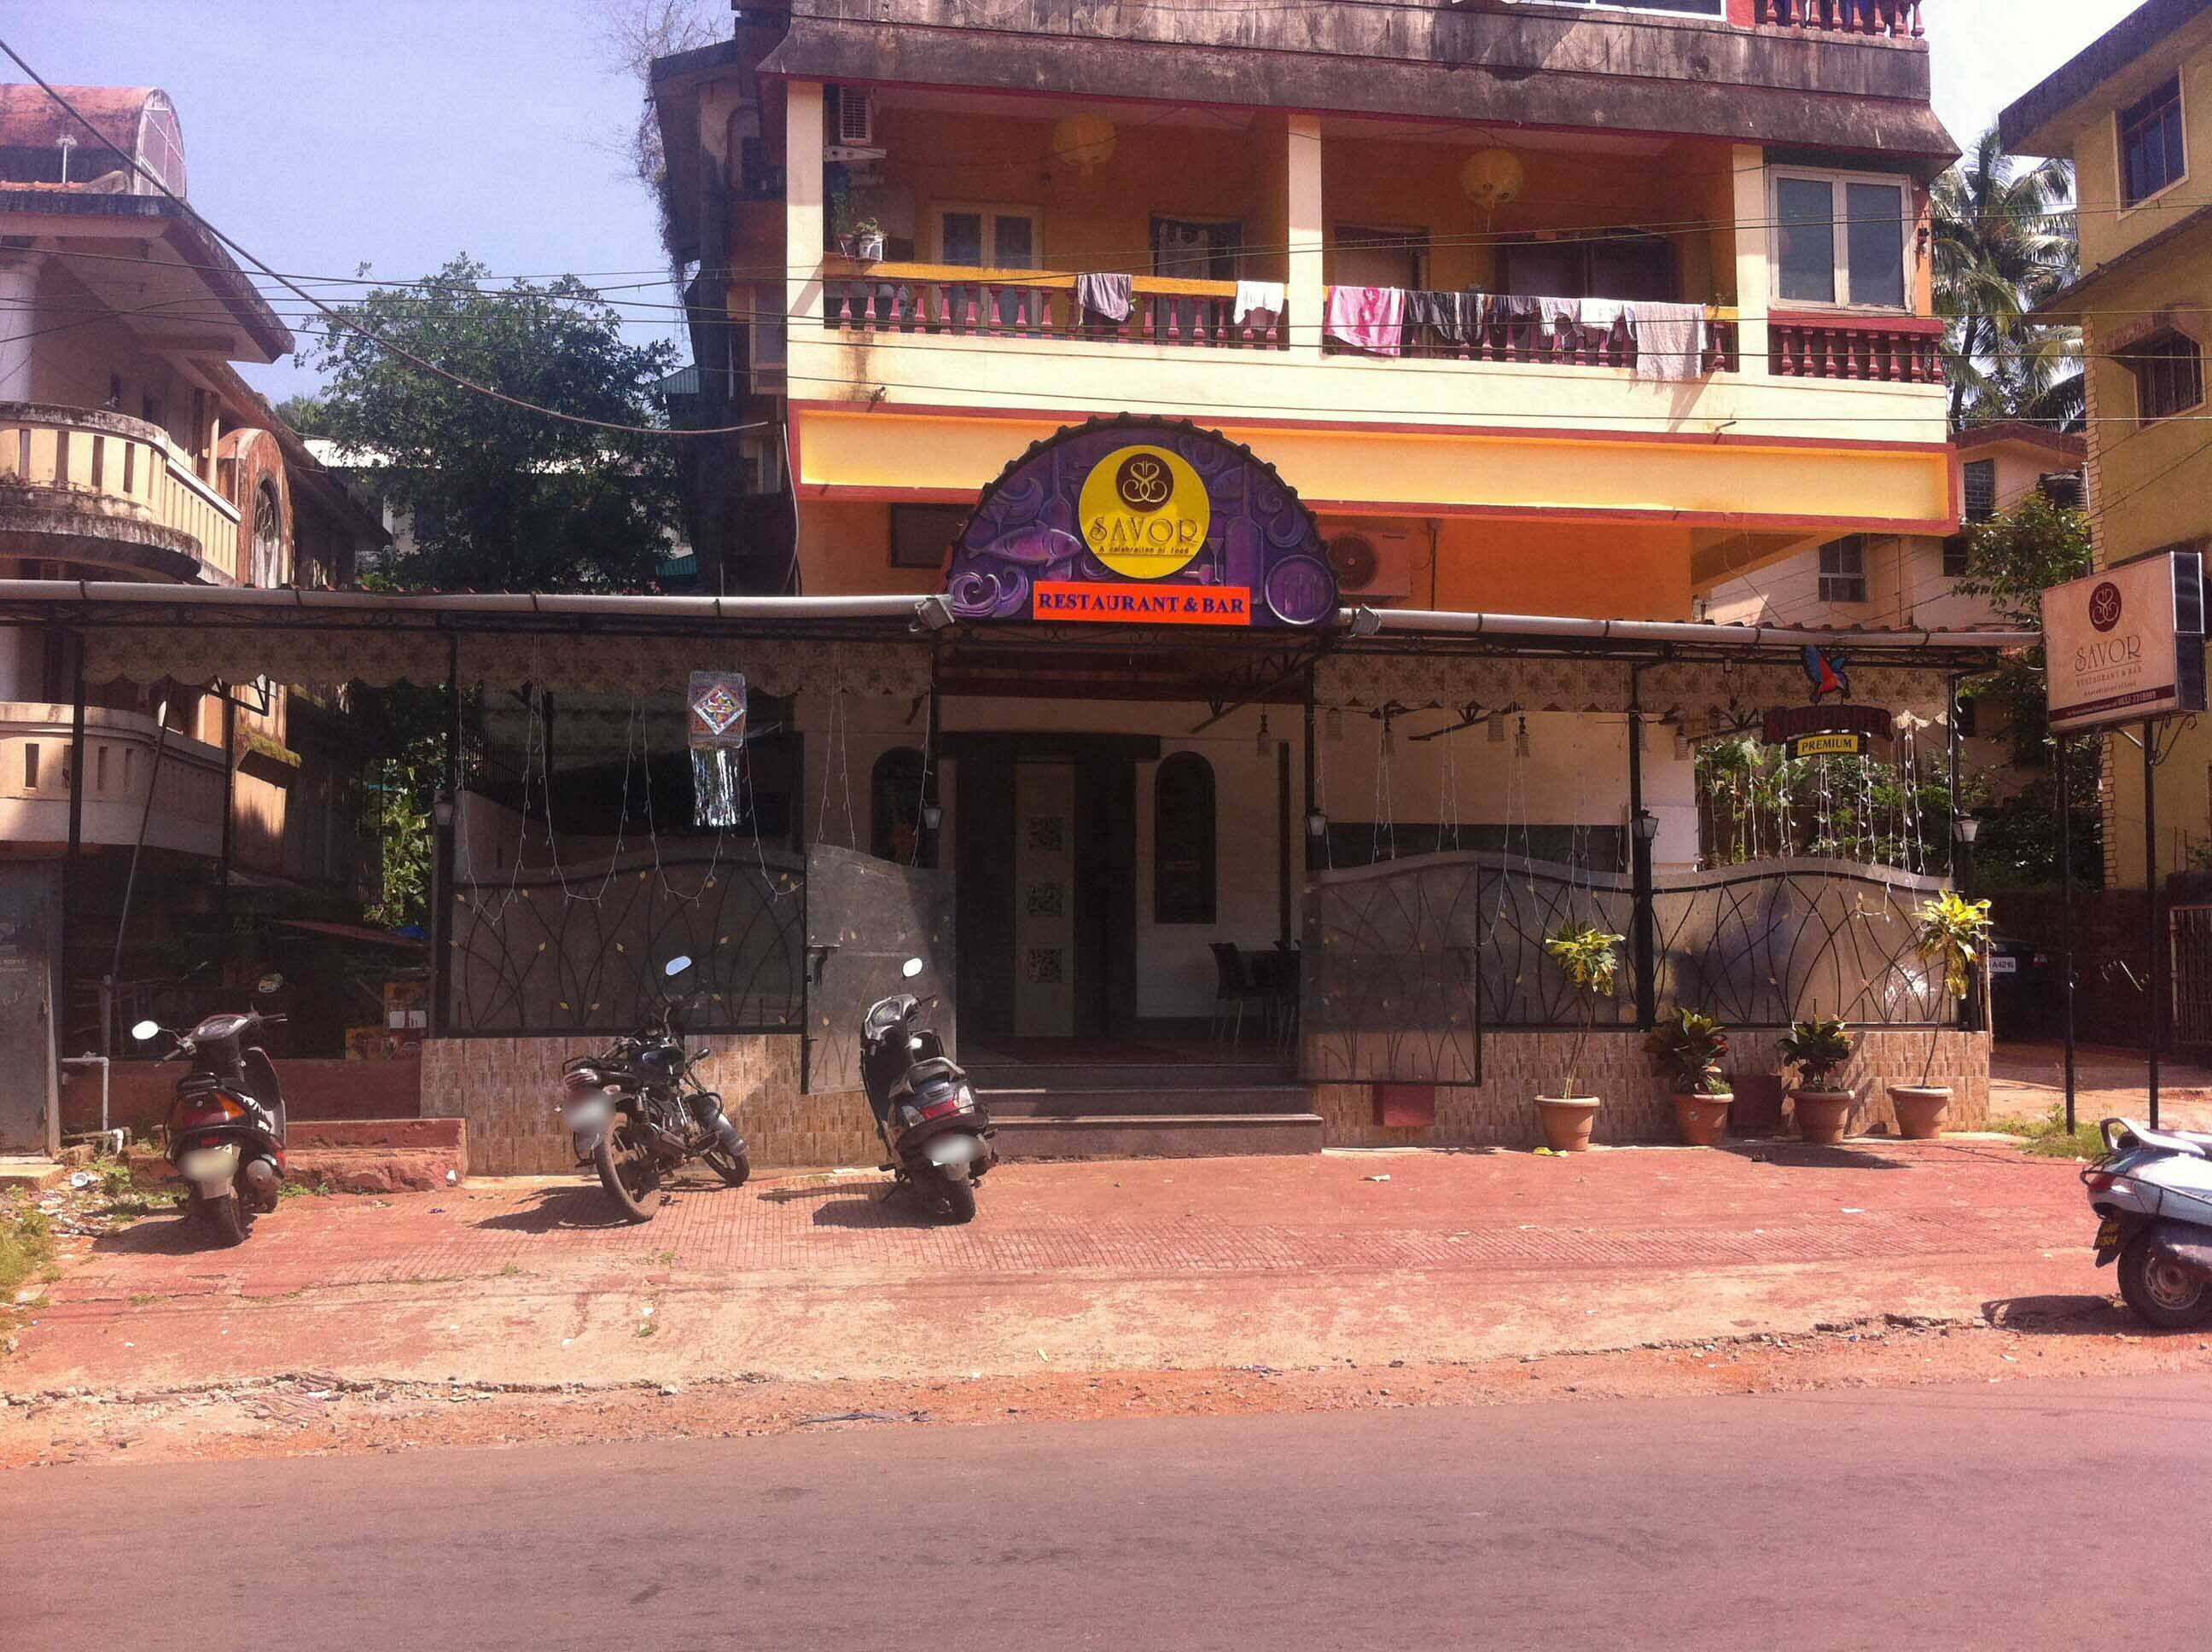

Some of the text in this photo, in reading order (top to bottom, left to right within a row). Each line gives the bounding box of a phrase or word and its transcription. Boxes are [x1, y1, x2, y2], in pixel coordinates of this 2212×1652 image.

[1090, 517, 1199, 544] SAVOR
[1109, 545, 1155, 554] celebration
[1171, 546, 1190, 555] food
[1038, 593, 1245, 614] RESTAURANT & BAR
[2075, 635, 2142, 672] SAVOR
[1802, 738, 1853, 752] PREMIUM
